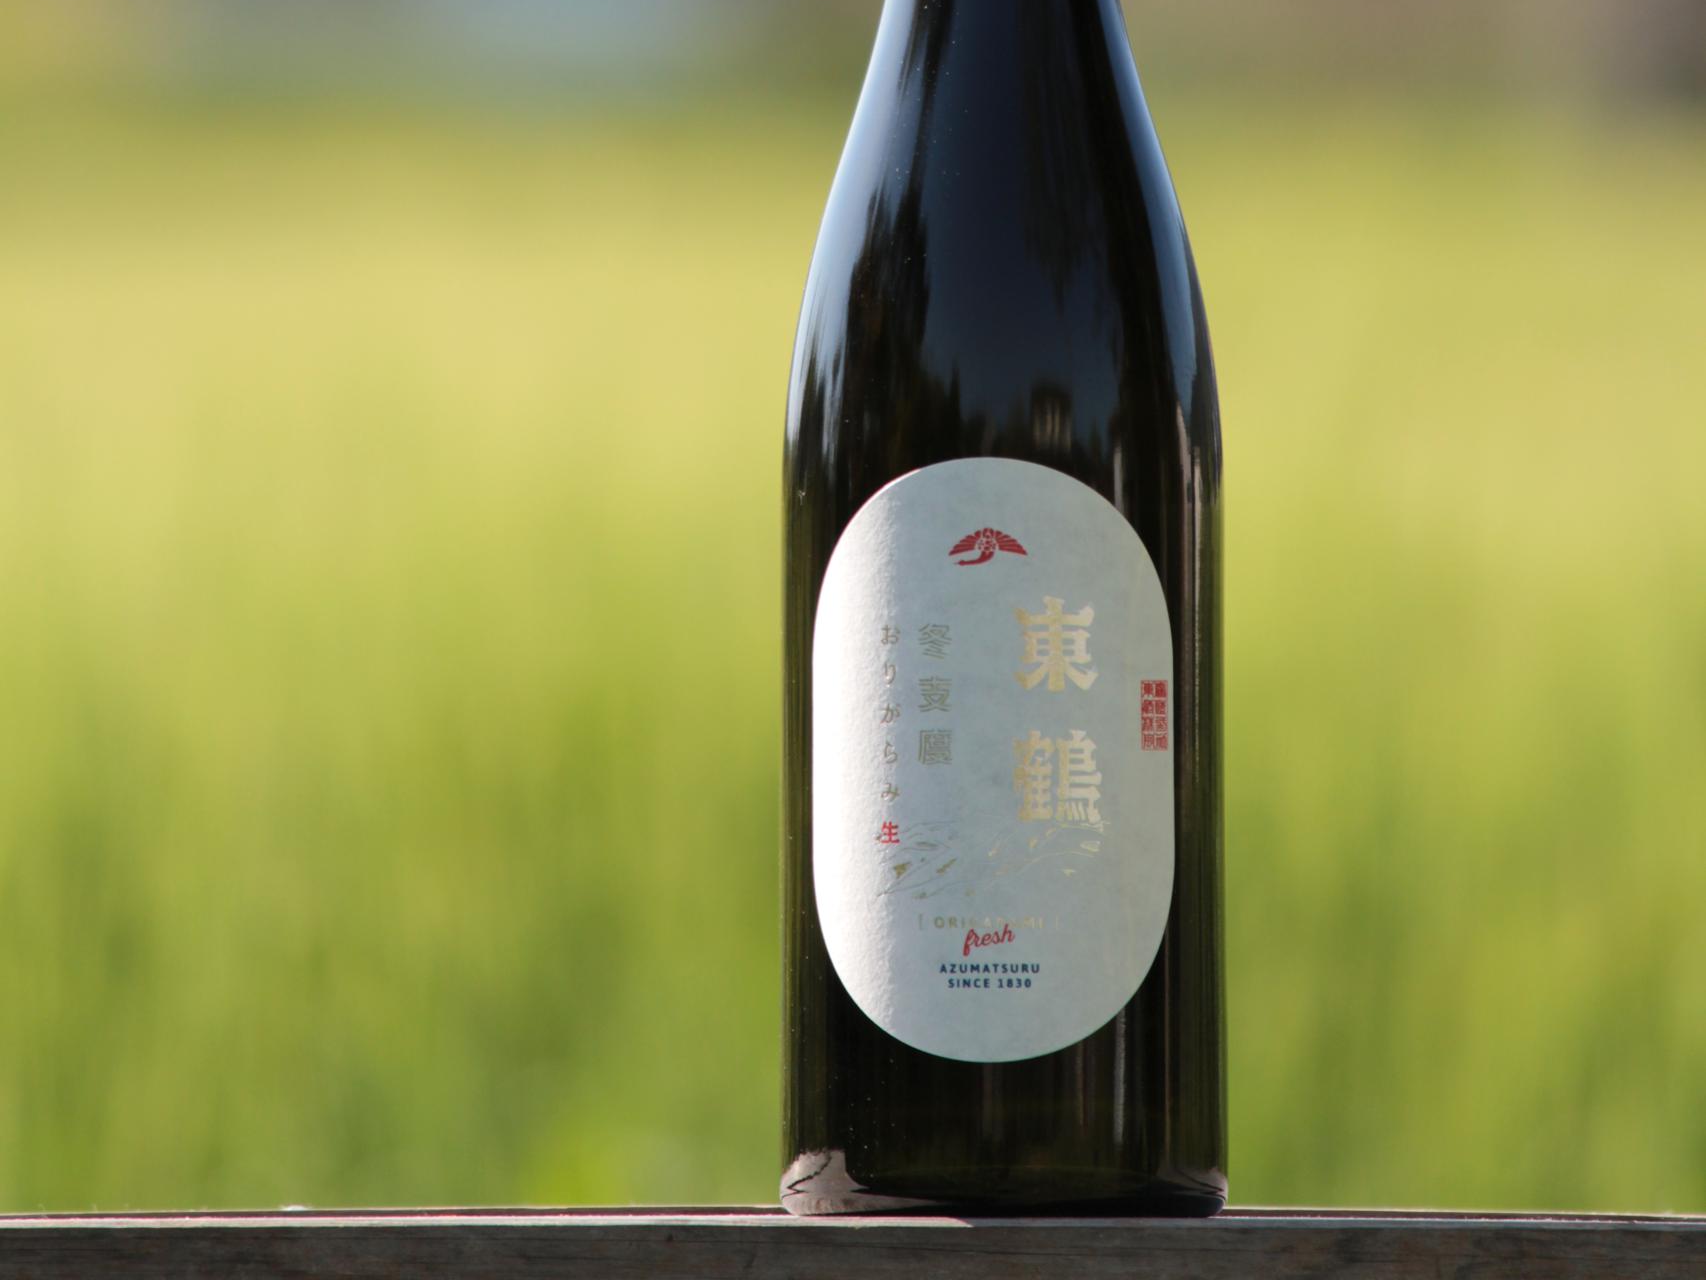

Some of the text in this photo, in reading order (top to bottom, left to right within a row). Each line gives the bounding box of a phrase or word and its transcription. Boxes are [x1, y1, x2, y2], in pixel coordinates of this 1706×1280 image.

[1013, 595, 1102, 826] 東鶴
[963, 924, 1015, 957] fresh
[939, 963, 1041, 974] AZUMATSURU
[947, 978, 1032, 989] SINCE 1830
